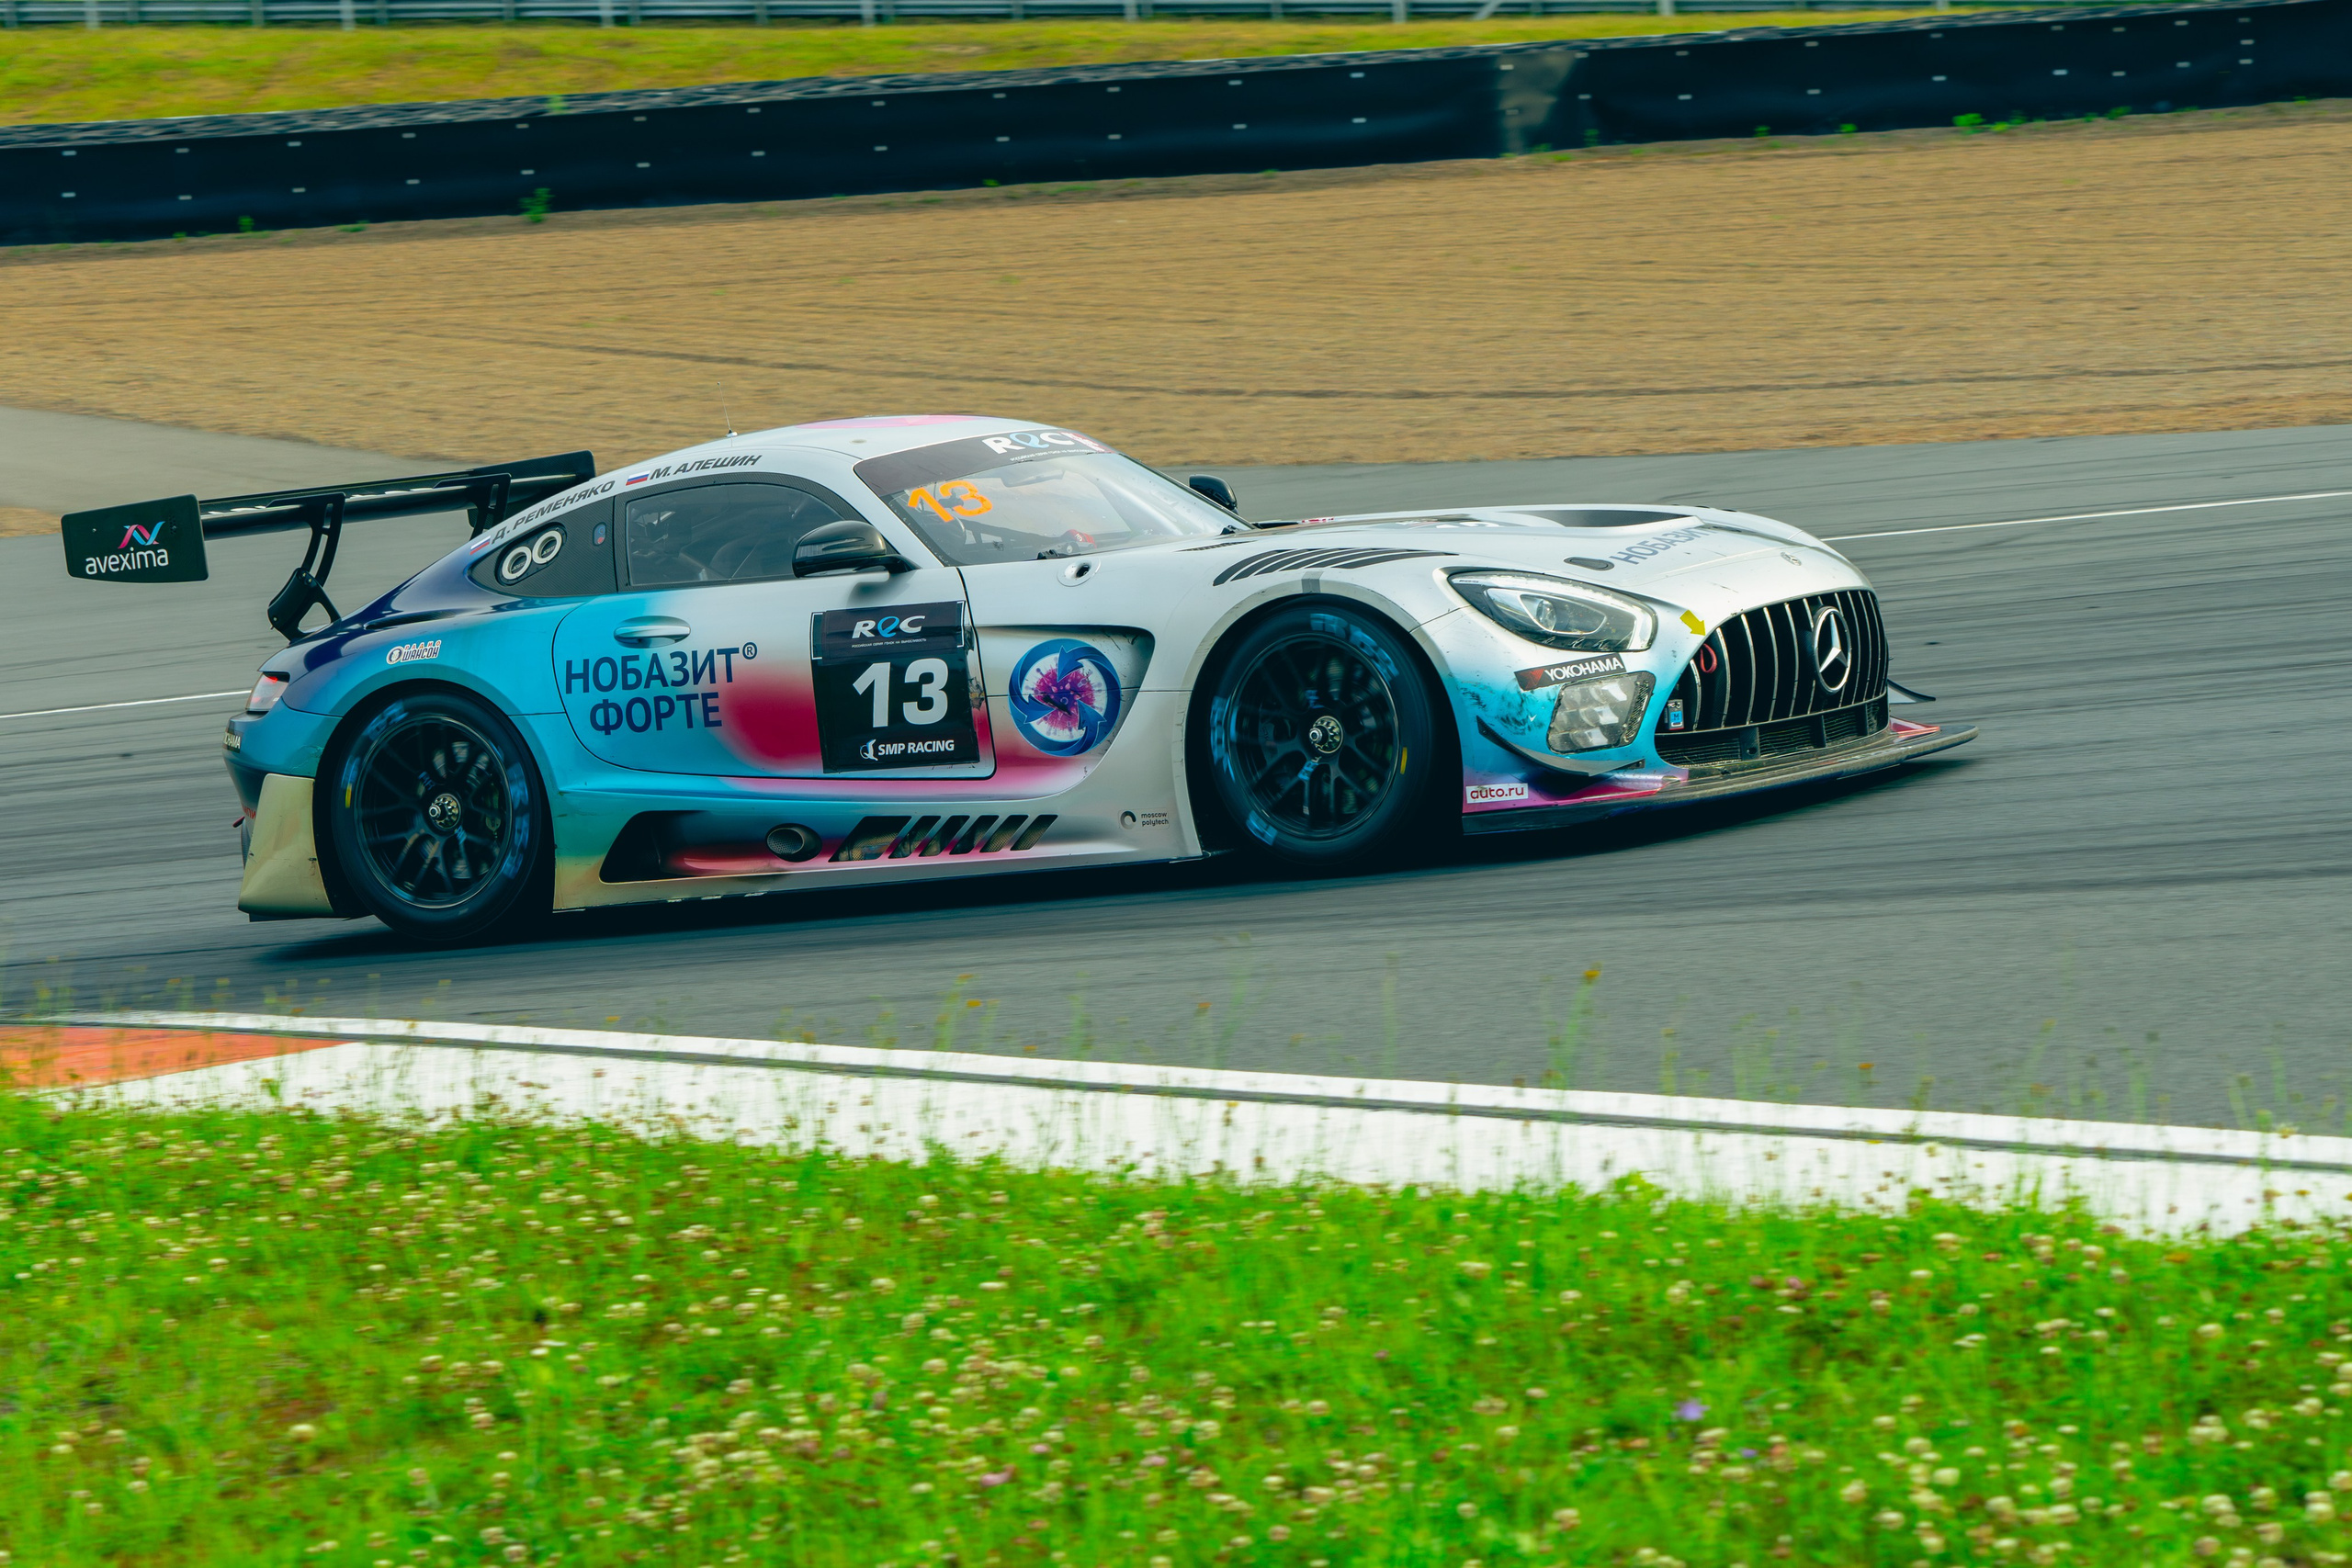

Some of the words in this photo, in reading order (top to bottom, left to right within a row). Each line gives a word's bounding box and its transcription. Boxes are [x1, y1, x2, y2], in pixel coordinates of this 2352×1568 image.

[650, 466, 672, 480] М.
[673, 455, 763, 475] АЛЕШИН
[491, 526, 511, 545] Д.
[513, 480, 616, 530] РЕМЕНЯКО
[907, 479, 993, 523] 13
[85, 547, 170, 575] avexima
[402, 647, 439, 661] ШАНСОН
[1544, 657, 1624, 682] YOKOHAMA
[853, 658, 949, 728] 13
[589, 692, 723, 736] ФОРТЕ
[877, 743, 906, 756] SMP
[907, 739, 956, 754] RACING
[1470, 786, 1525, 800] auto.ru
[1141, 818, 1169, 827] polytech
